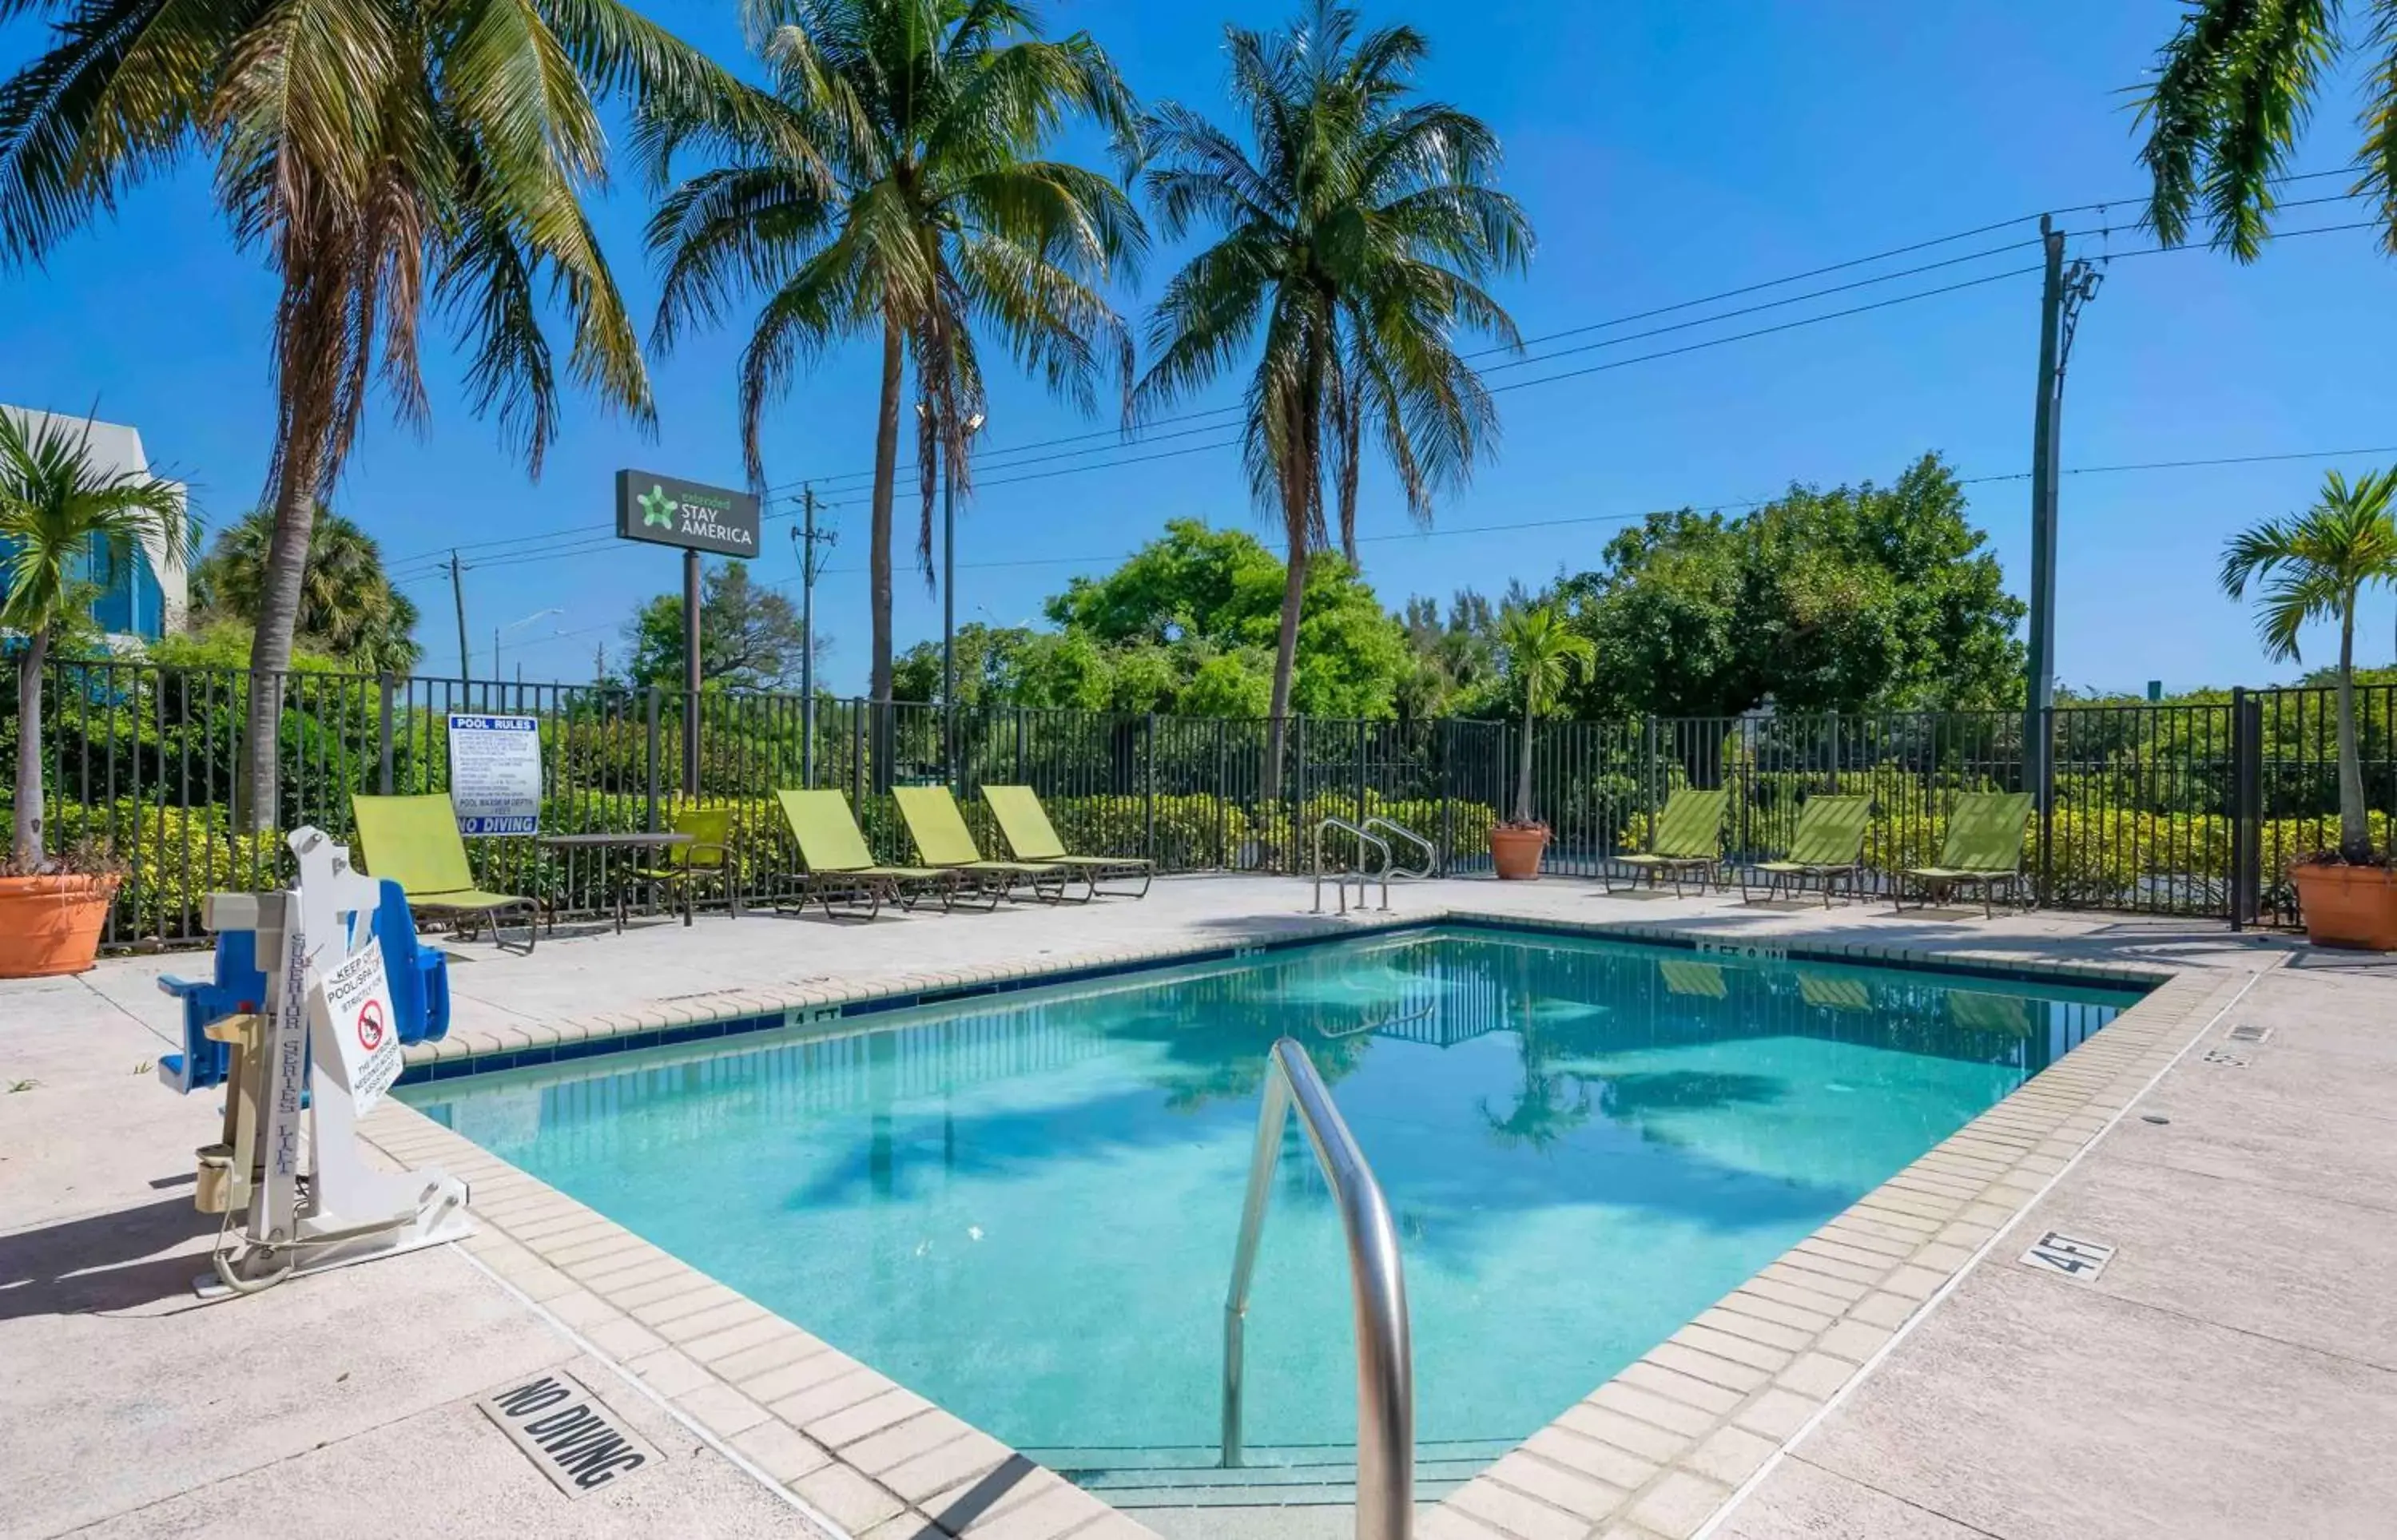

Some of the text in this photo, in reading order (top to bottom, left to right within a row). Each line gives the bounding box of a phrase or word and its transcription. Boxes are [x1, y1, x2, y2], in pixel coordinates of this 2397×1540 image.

[681, 503, 718, 522] STAY
[681, 519, 752, 545] AMERICA
[458, 718, 531, 729] POOL RULES
[458, 817, 533, 832] NO DIVING
[336, 958, 362, 981] KEEP
[796, 1008, 838, 1024] 4 FT
[276, 933, 306, 1174] SUPERIOR SERIES LIFT
[492, 1376, 646, 1491] NO DIVING
